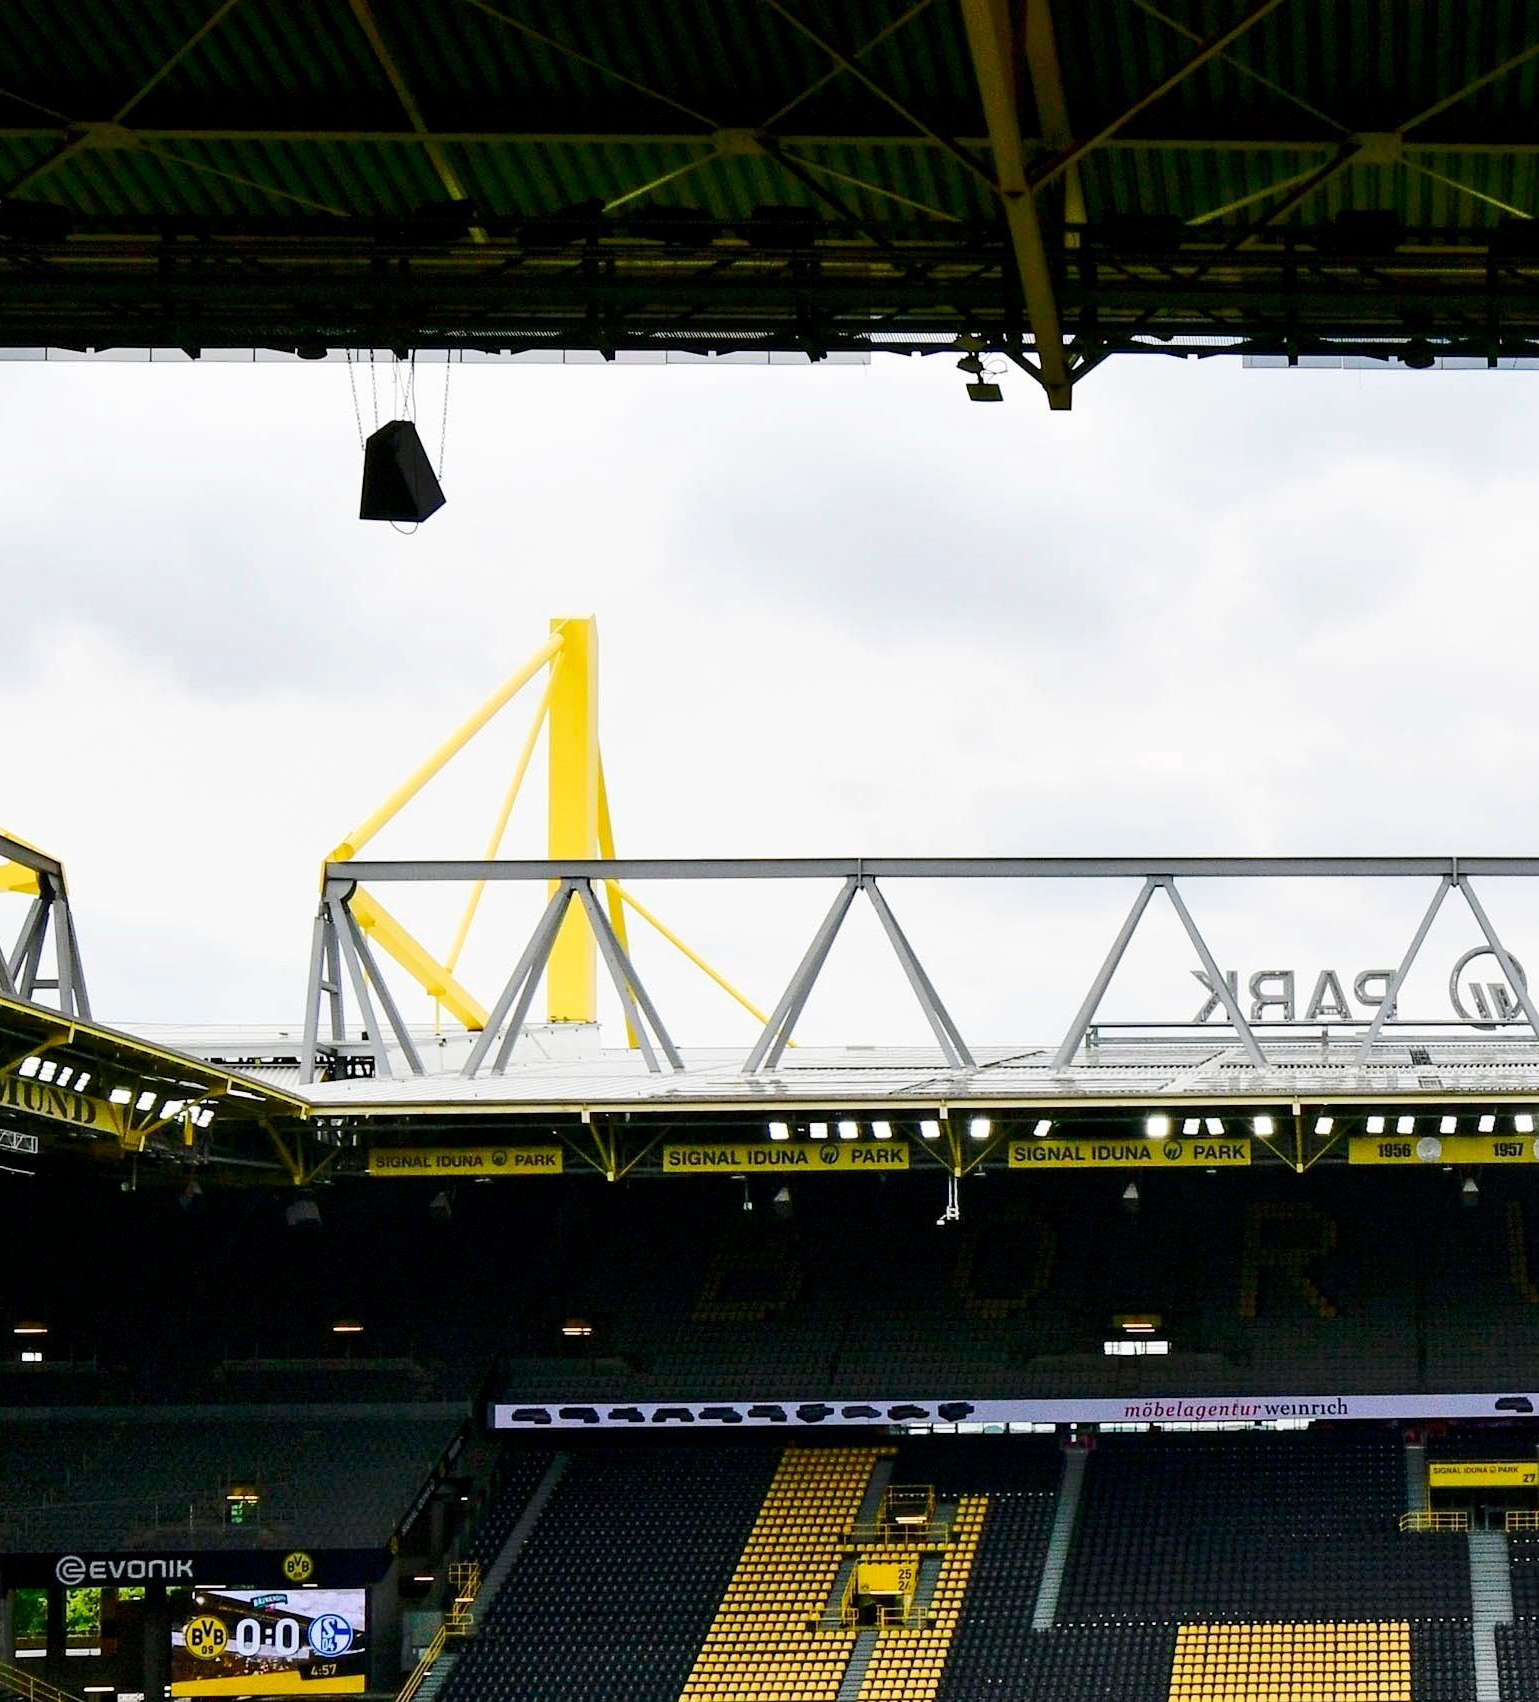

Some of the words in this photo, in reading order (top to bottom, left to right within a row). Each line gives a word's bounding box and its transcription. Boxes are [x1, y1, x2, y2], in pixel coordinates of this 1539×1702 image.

[668, 1148, 741, 1166] SIGNAL
[748, 1147, 808, 1165] IDUNA
[852, 1147, 904, 1163] PARK
[1013, 1145, 1086, 1163] SIGNAL
[1091, 1144, 1151, 1161] IDUNA
[1193, 1144, 1245, 1160] PARK
[1377, 1142, 1411, 1158] 1956
[1493, 1141, 1524, 1157] 1957
[375, 1152, 431, 1169] SIGNAL
[436, 1152, 484, 1168] IDUNA
[515, 1152, 556, 1167] PARK
[1125, 1398, 1261, 1420] möbelagentur
[1523, 1474, 1536, 1483] 27
[89, 1559, 193, 1579] EVONIK
[236, 1618, 300, 1657] 0:0
[311, 1663, 337, 1676] 4:57
